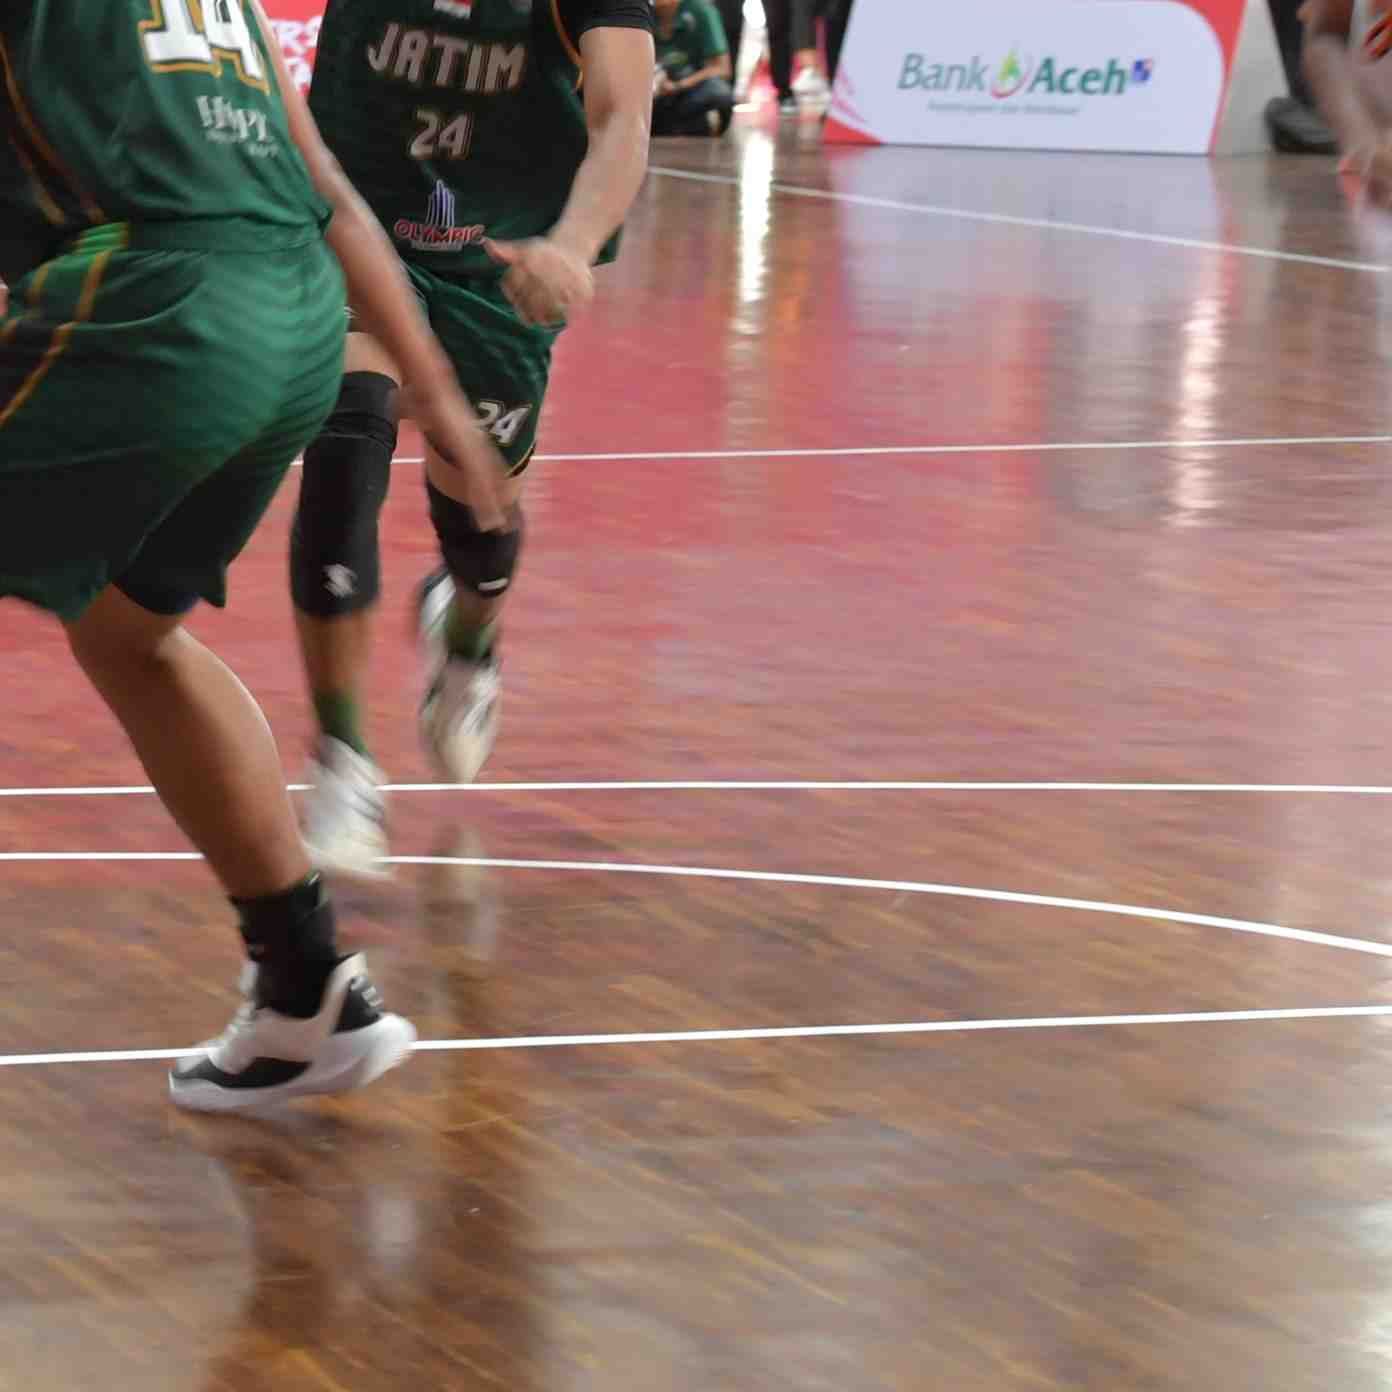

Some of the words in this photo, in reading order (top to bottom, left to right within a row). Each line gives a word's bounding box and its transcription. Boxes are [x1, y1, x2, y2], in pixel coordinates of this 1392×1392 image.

[367, 22, 528, 95] JATIM
[896, 51, 989, 92] Bank
[1027, 55, 1129, 97] Aceh
[409, 108, 475, 158] 24
